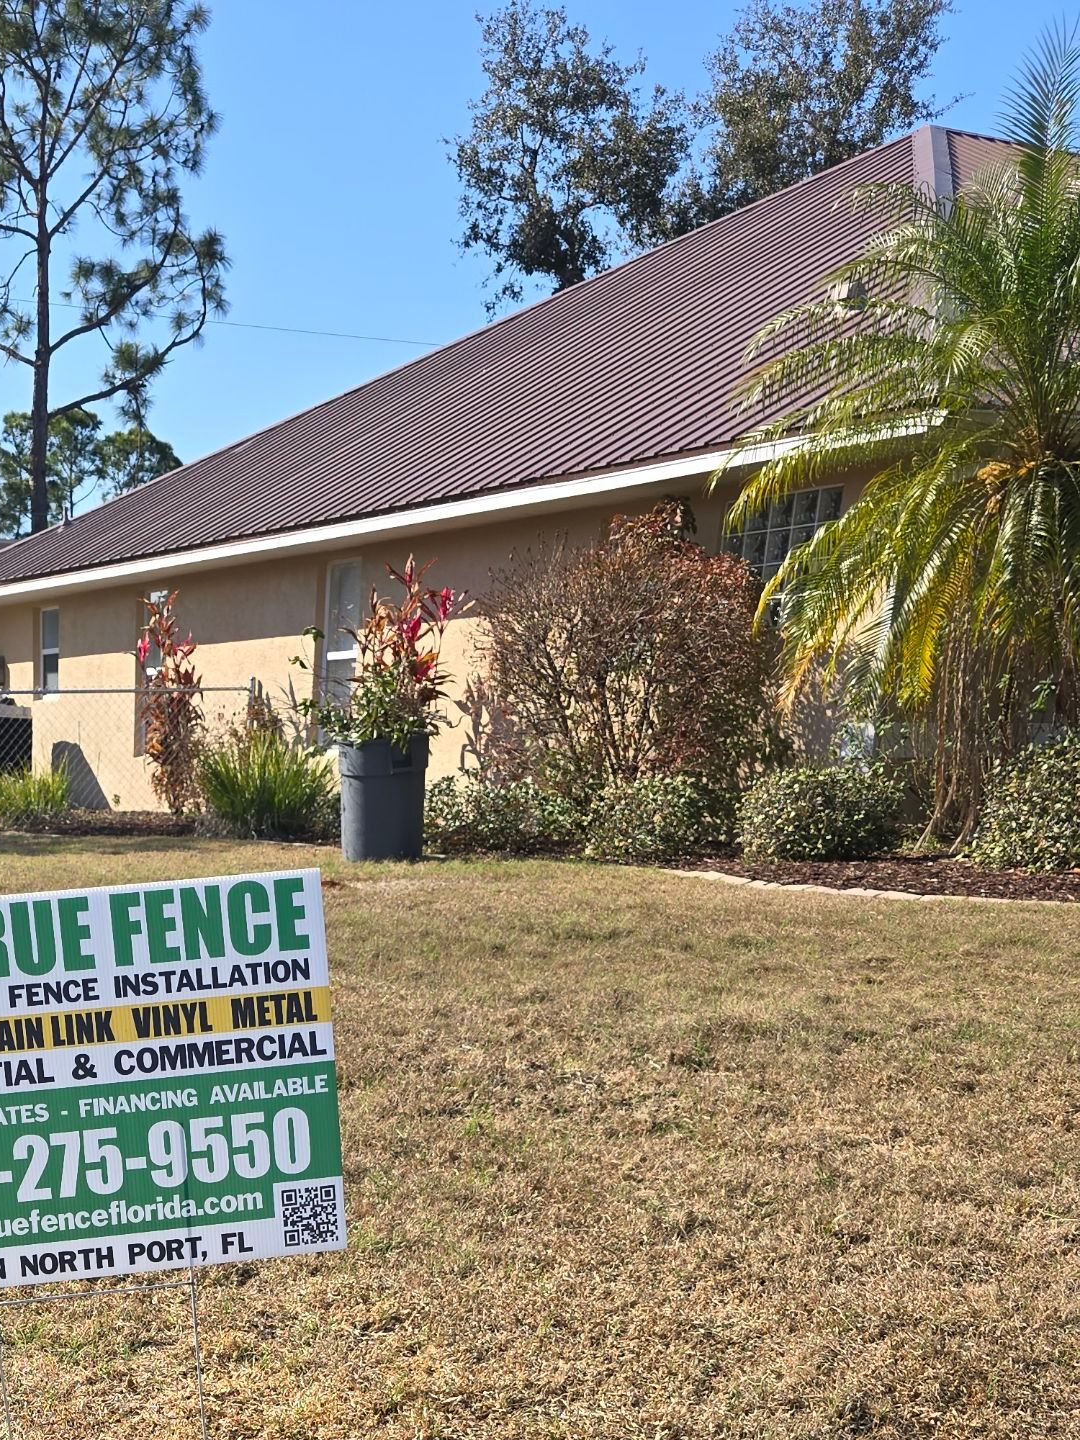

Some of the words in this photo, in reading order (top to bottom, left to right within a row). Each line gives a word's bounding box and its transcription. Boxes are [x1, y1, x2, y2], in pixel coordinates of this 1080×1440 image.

[109, 878, 310, 968] FENCE
[8, 978, 100, 1008] FENCE
[114, 958, 310, 998] INSTALLATION
[51, 1011, 115, 1047] LINK
[132, 1002, 212, 1037] VINYL
[231, 992, 317, 1029] METAL
[72, 1054, 97, 1079] &
[115, 1031, 327, 1074] COMMERCIAL
[79, 1088, 198, 1119] FINANCING
[209, 1074, 328, 1104] AVAILABLE
[20, 1245, 114, 1276] NORTH
[128, 1236, 208, 1265] PORT,
[221, 1231, 253, 1254] FL
